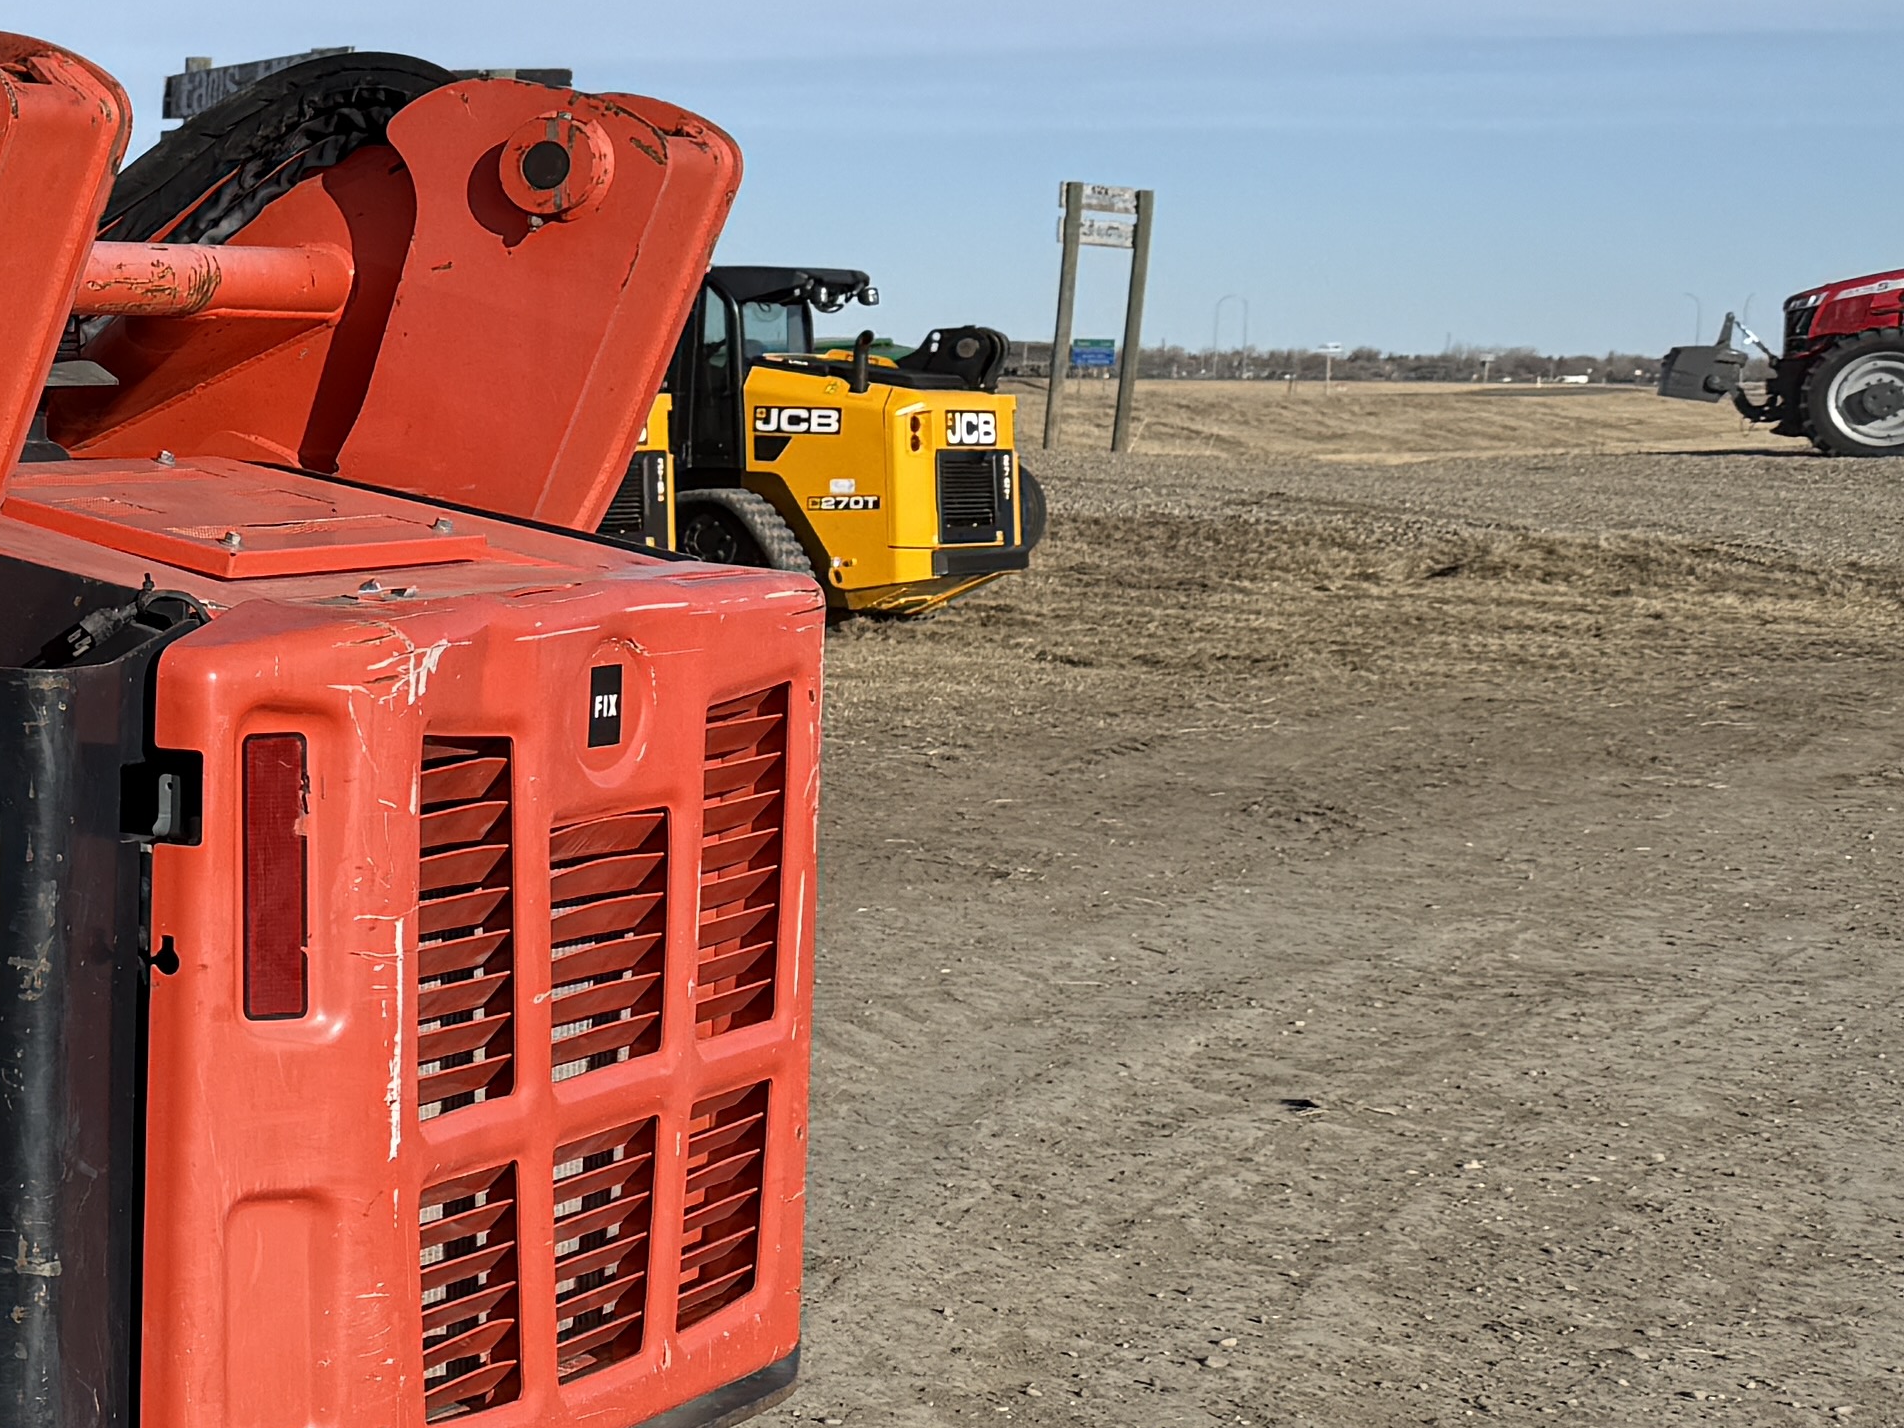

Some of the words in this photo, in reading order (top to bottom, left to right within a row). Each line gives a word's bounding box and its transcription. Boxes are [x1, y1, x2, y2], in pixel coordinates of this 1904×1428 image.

[755, 407, 839, 433] JCB
[947, 412, 996, 445] JCB
[820, 495, 878, 510] 270T
[594, 694, 618, 719] FIX
